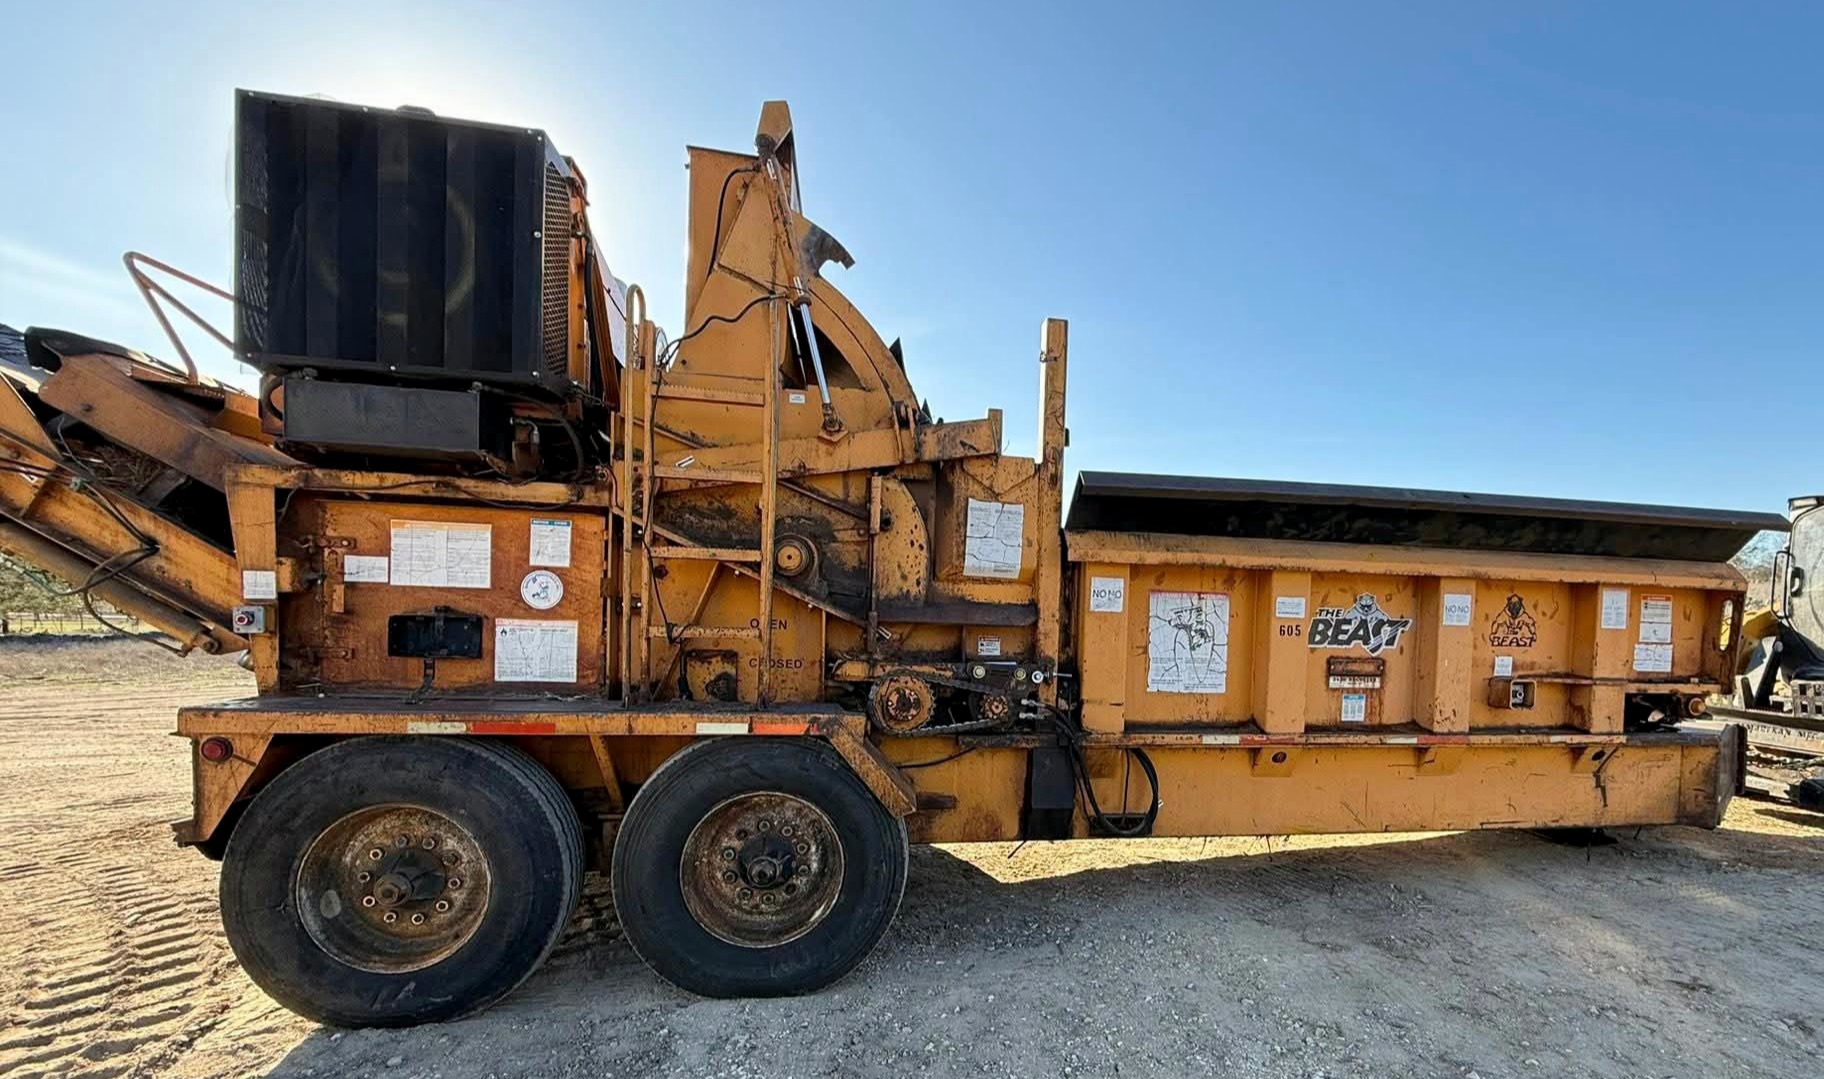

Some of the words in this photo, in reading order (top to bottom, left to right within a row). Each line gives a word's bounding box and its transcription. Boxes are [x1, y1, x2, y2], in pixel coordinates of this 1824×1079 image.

[1318, 608, 1343, 618] THE
[750, 618, 788, 630] OEN
[1279, 624, 1302, 637] 605
[1308, 618, 1412, 656] BEAST
[1491, 635, 1537, 647] BEAST
[749, 658, 803, 669] COSED
